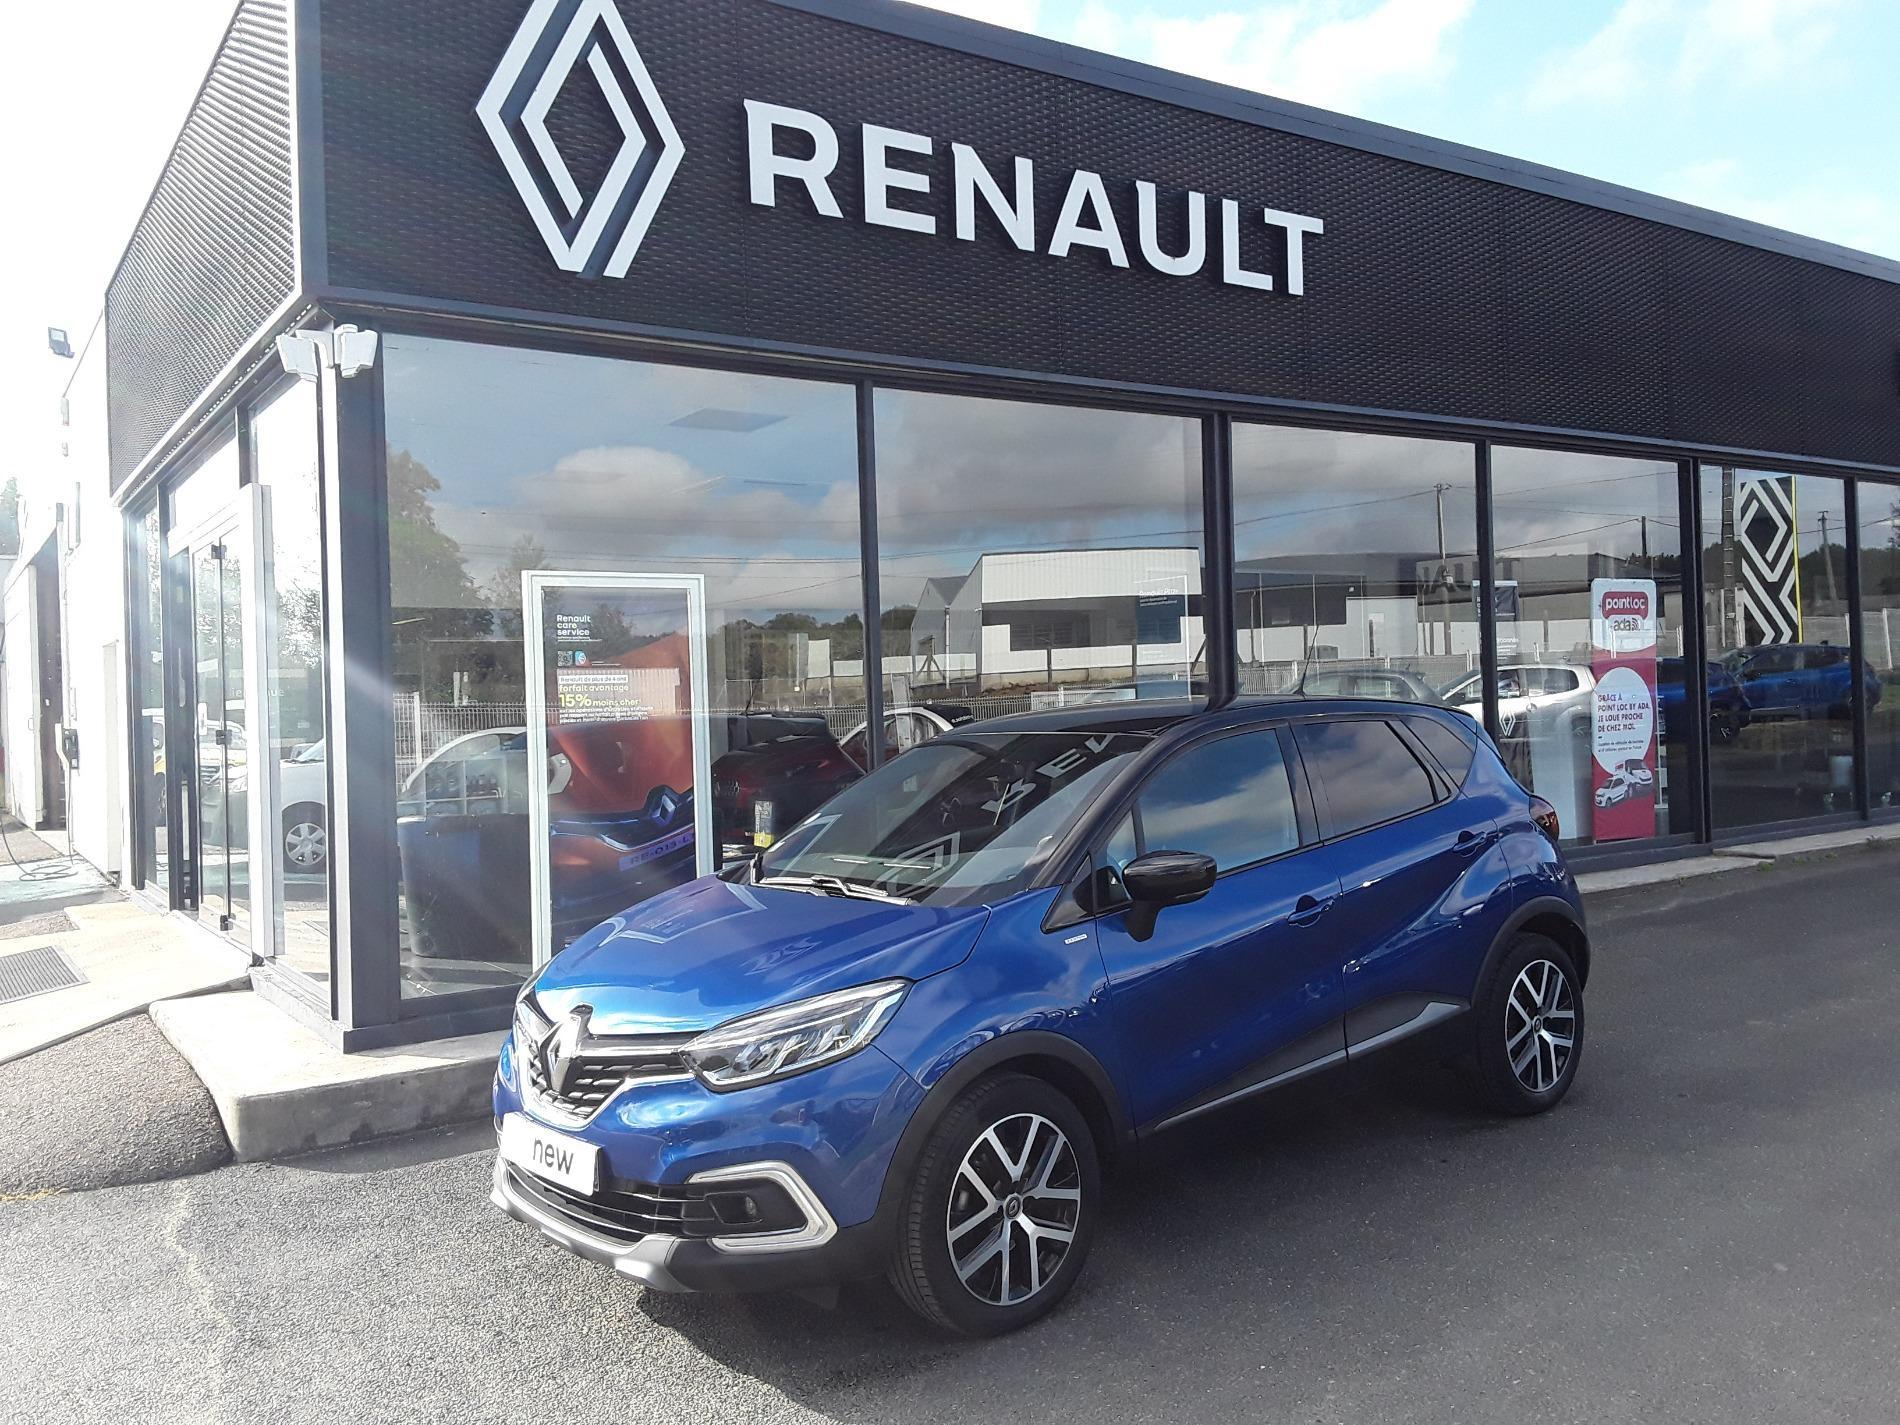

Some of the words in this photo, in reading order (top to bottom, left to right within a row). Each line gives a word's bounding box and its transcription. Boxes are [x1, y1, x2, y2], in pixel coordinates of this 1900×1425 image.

[744, 98, 1324, 296] RENAULT
[556, 614, 591, 623] Renault
[1613, 618, 1631, 631] ada
[557, 628, 590, 636] service
[559, 684, 588, 692] forfait
[588, 684, 629, 692] avantage
[559, 693, 592, 707] 15%
[592, 699, 619, 707] moins
[1597, 704, 1616, 712] POINT
[1616, 703, 1628, 711] LOC
[1597, 714, 1604, 722] JE
[1606, 723, 1621, 731] CHEZ
[532, 1138, 574, 1175] new
